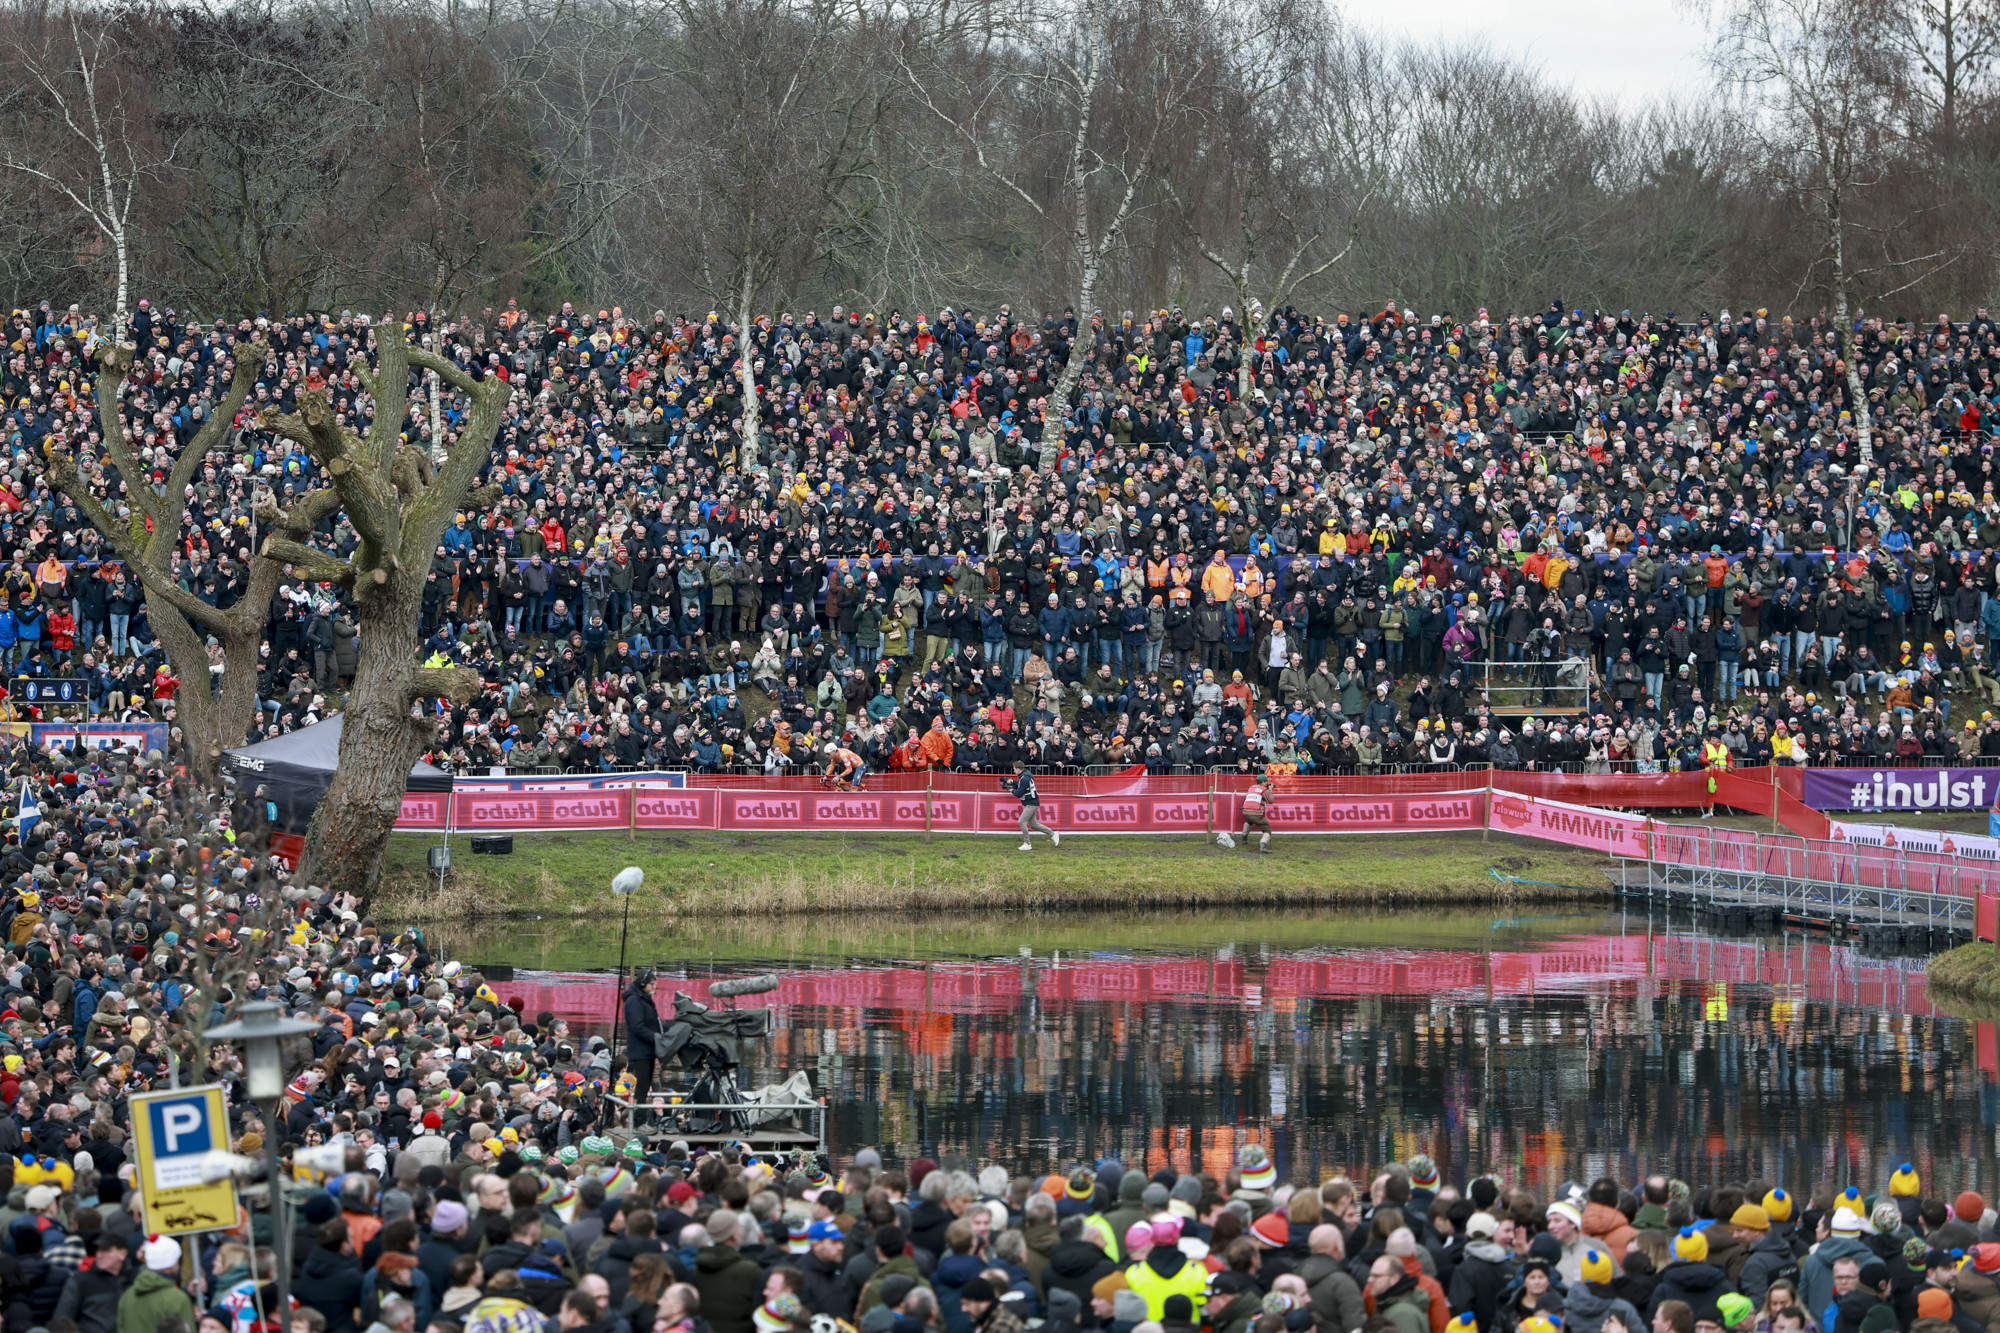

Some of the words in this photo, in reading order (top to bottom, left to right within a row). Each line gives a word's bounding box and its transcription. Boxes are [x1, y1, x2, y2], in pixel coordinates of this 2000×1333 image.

[240, 756, 265, 772] EMG
[1850, 771, 1986, 807] #ihulst
[162, 1103, 202, 1152] P
